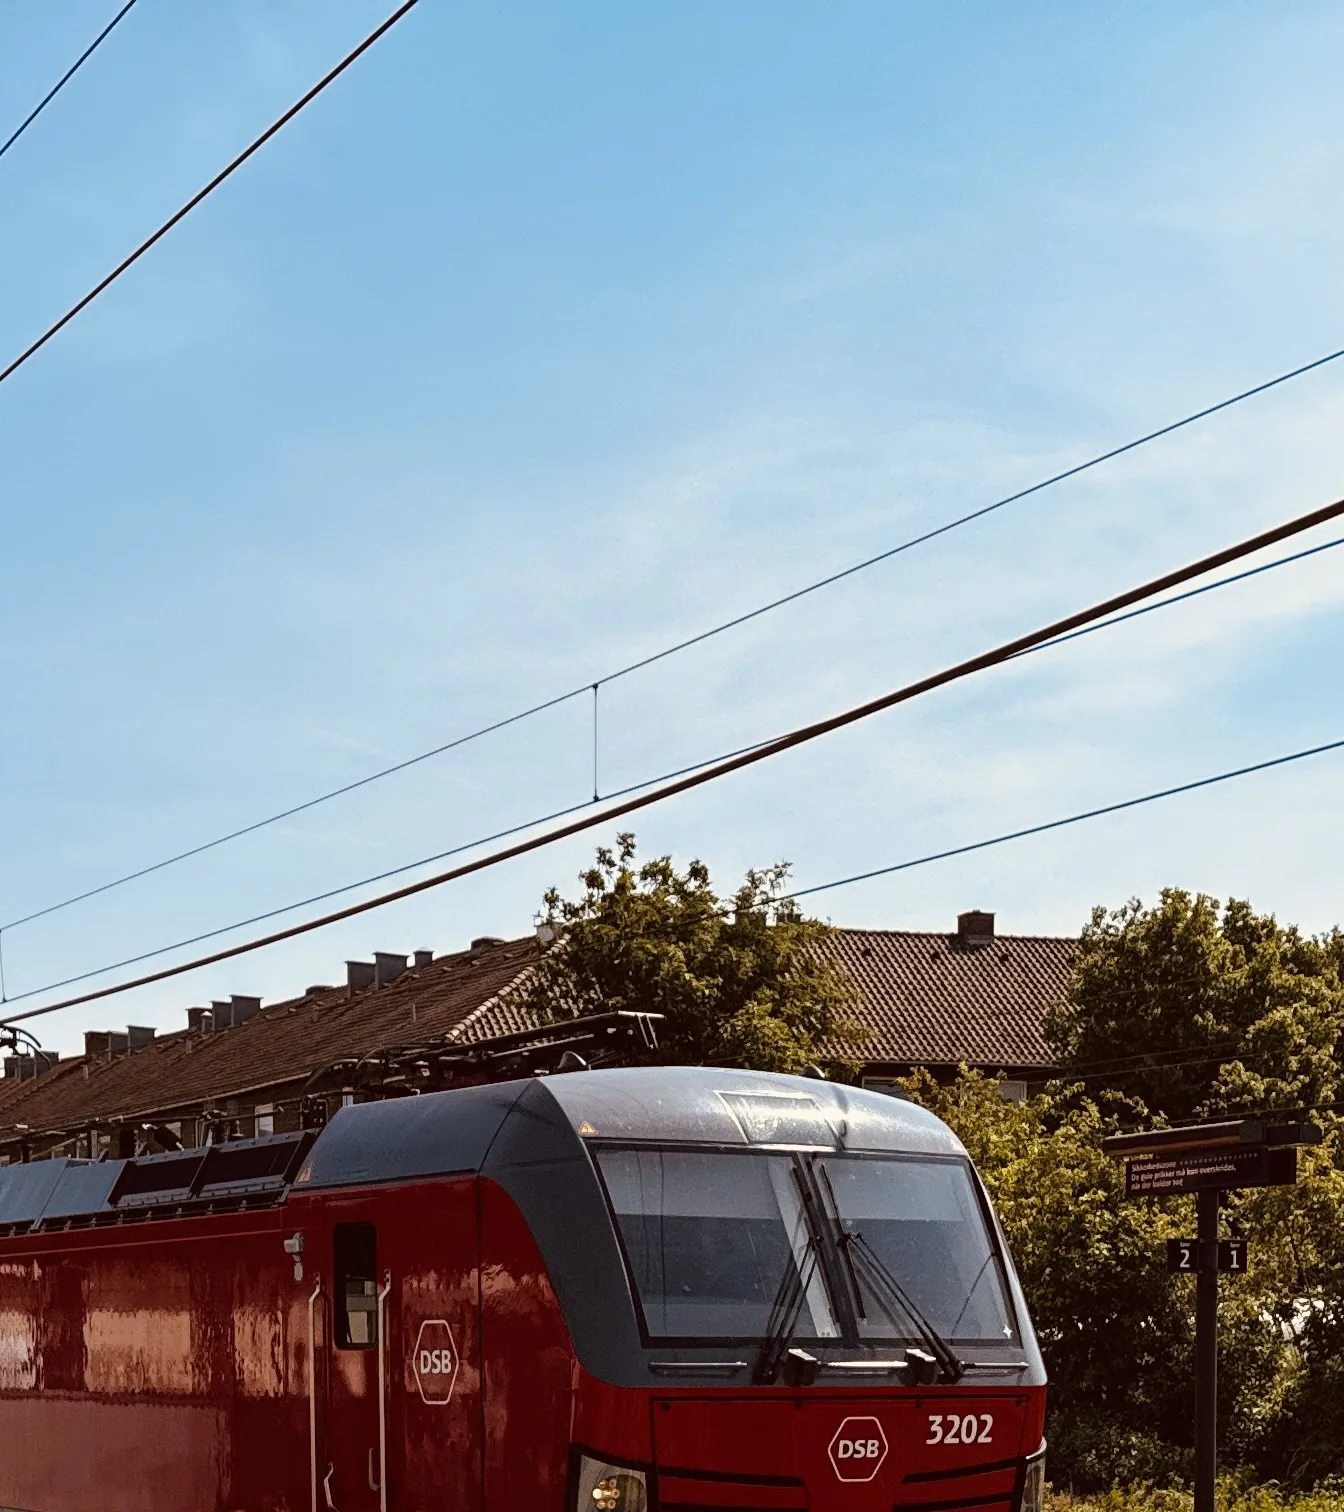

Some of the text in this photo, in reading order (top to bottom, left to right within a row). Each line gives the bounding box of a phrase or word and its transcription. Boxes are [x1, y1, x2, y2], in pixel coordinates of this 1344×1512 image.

[1180, 1249, 1191, 1268] 2
[1230, 1250, 1240, 1269] 1
[420, 1349, 452, 1374] DSB
[926, 1414, 994, 1445] 3202
[837, 1439, 880, 1459] DSB
